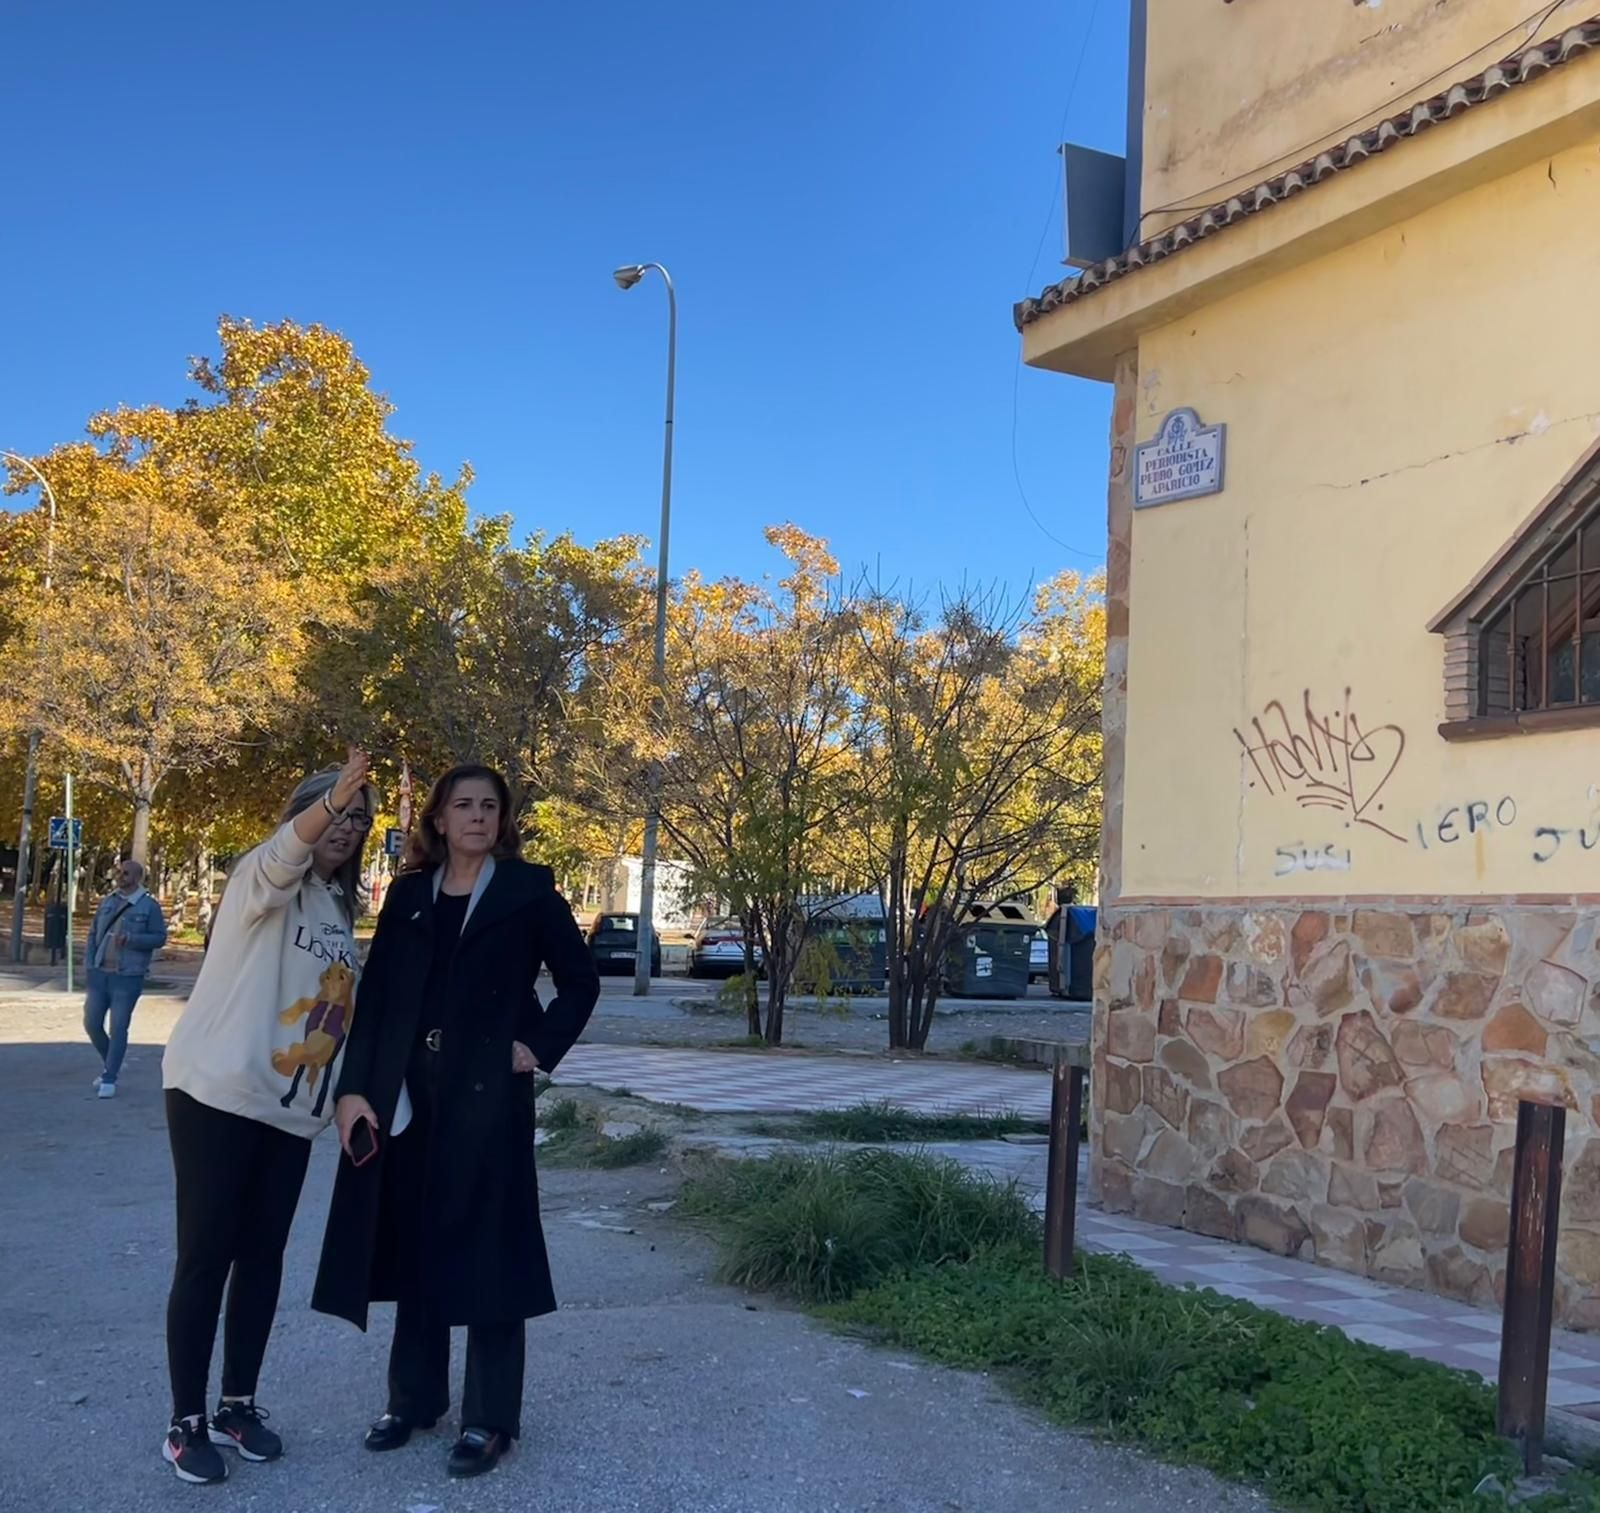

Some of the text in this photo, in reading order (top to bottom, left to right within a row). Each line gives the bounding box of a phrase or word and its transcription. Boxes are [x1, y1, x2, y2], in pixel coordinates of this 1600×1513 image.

[1157, 441, 1193, 457] CALLE
[1145, 448, 1208, 472] PERIODISTA
[1141, 468, 1173, 486] PEDRO
[1152, 474, 1200, 495] APARICIO
[293, 925, 336, 962] LION
